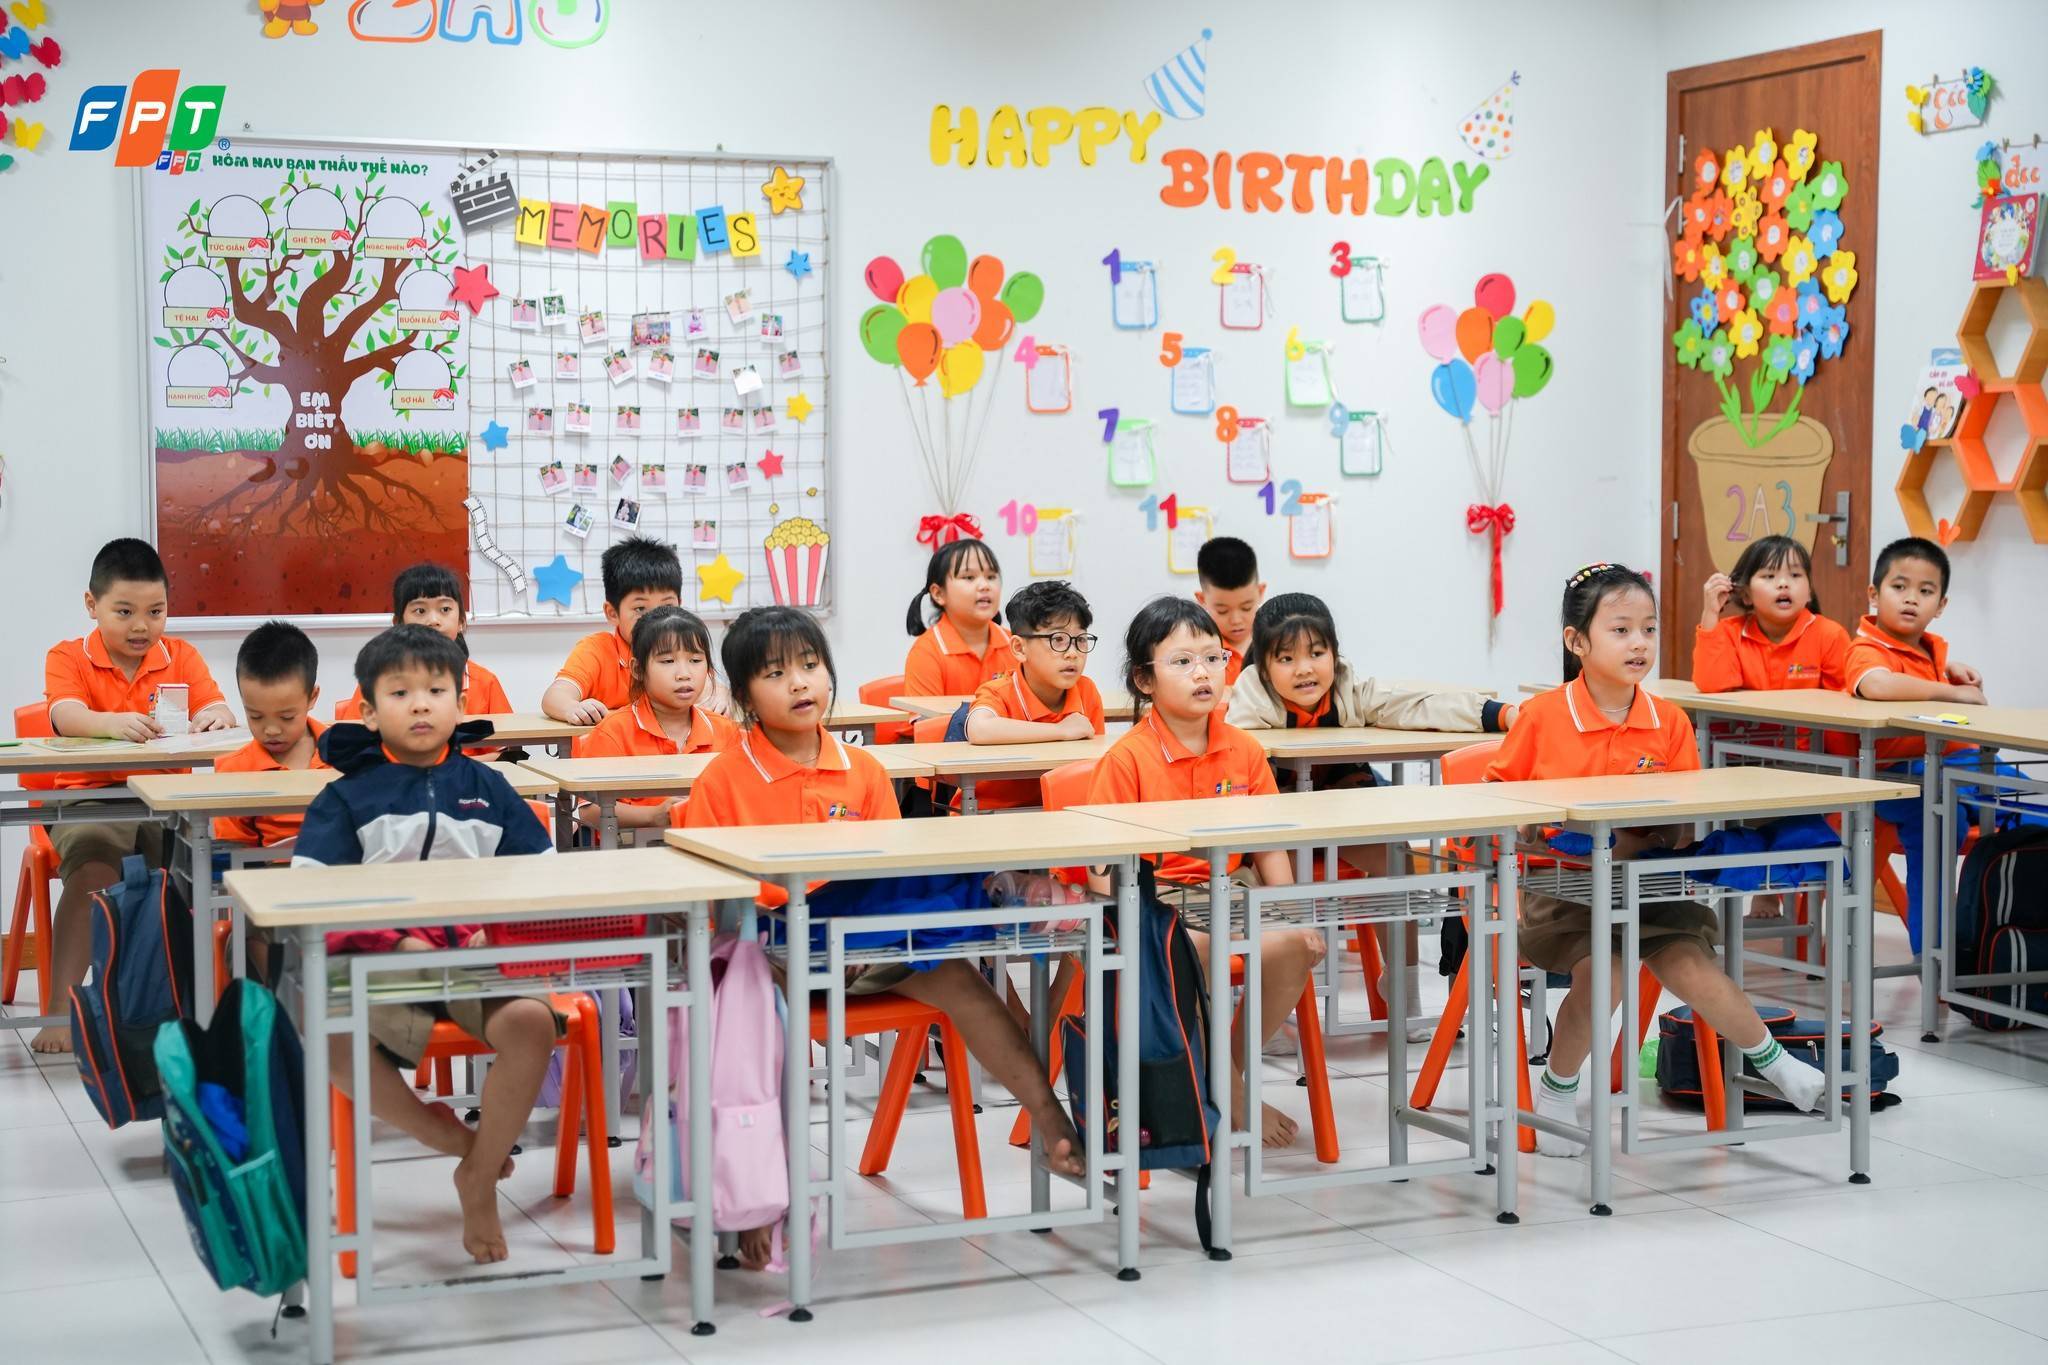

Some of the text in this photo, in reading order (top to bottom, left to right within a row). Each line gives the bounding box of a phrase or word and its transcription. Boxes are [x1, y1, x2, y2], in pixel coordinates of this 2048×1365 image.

[212, 153, 249, 168] HÔM
[286, 158, 316, 173] BẠN
[360, 156, 387, 173] THẾ
[390, 160, 429, 176] NÀO?
[930, 104, 1490, 217] HAPPY BIRTHDAY
[520, 206, 756, 254] MEMORIES
[1102, 248, 1121, 285] 1
[1211, 247, 1236, 286] 2
[1329, 241, 1352, 277] 3
[1014, 336, 1039, 369] 4
[1159, 332, 1183, 367] 5
[1285, 325, 1305, 362] 6
[295, 406, 336, 428] BIẾT
[300, 391, 330, 407] EM
[1098, 408, 1119, 443] 7
[1216, 405, 1239, 442] 8
[1329, 402, 1349, 438] 9
[304, 432, 332, 449] ƠN
[1139, 492, 1178, 531] 11
[1257, 479, 1303, 516] 12
[1727, 480, 1796, 541] 2A3
[998, 499, 1038, 536] 10
